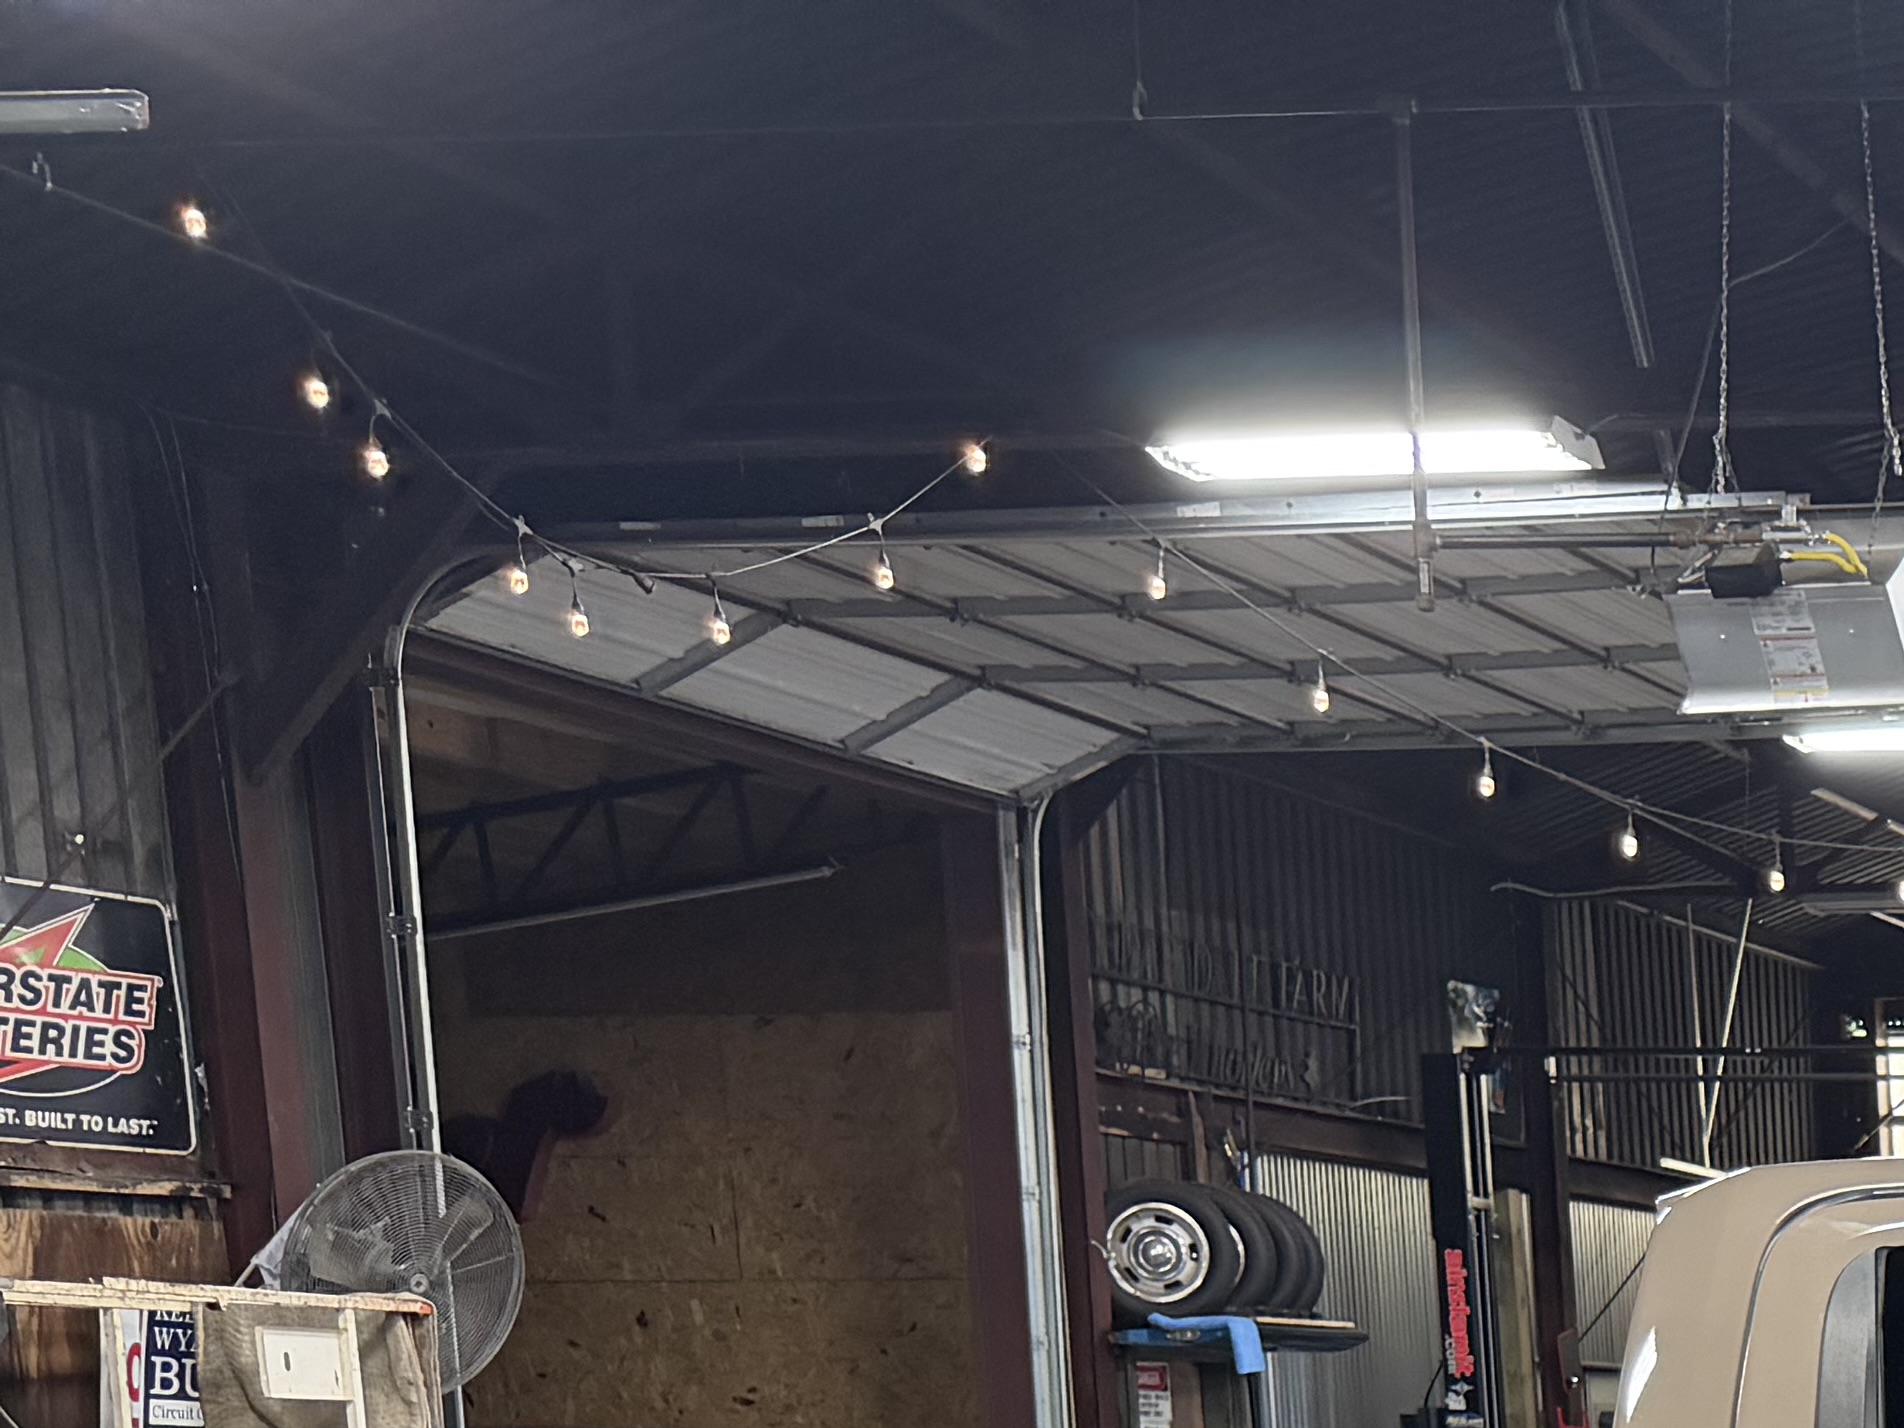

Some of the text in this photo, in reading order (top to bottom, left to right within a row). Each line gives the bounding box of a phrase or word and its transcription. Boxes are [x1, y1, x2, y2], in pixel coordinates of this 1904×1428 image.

[25, 1110, 76, 1129] BUILT
[80, 1114, 103, 1131] TO
[107, 1115, 155, 1135] LAST.
[152, 1406, 194, 1419] Circuit
